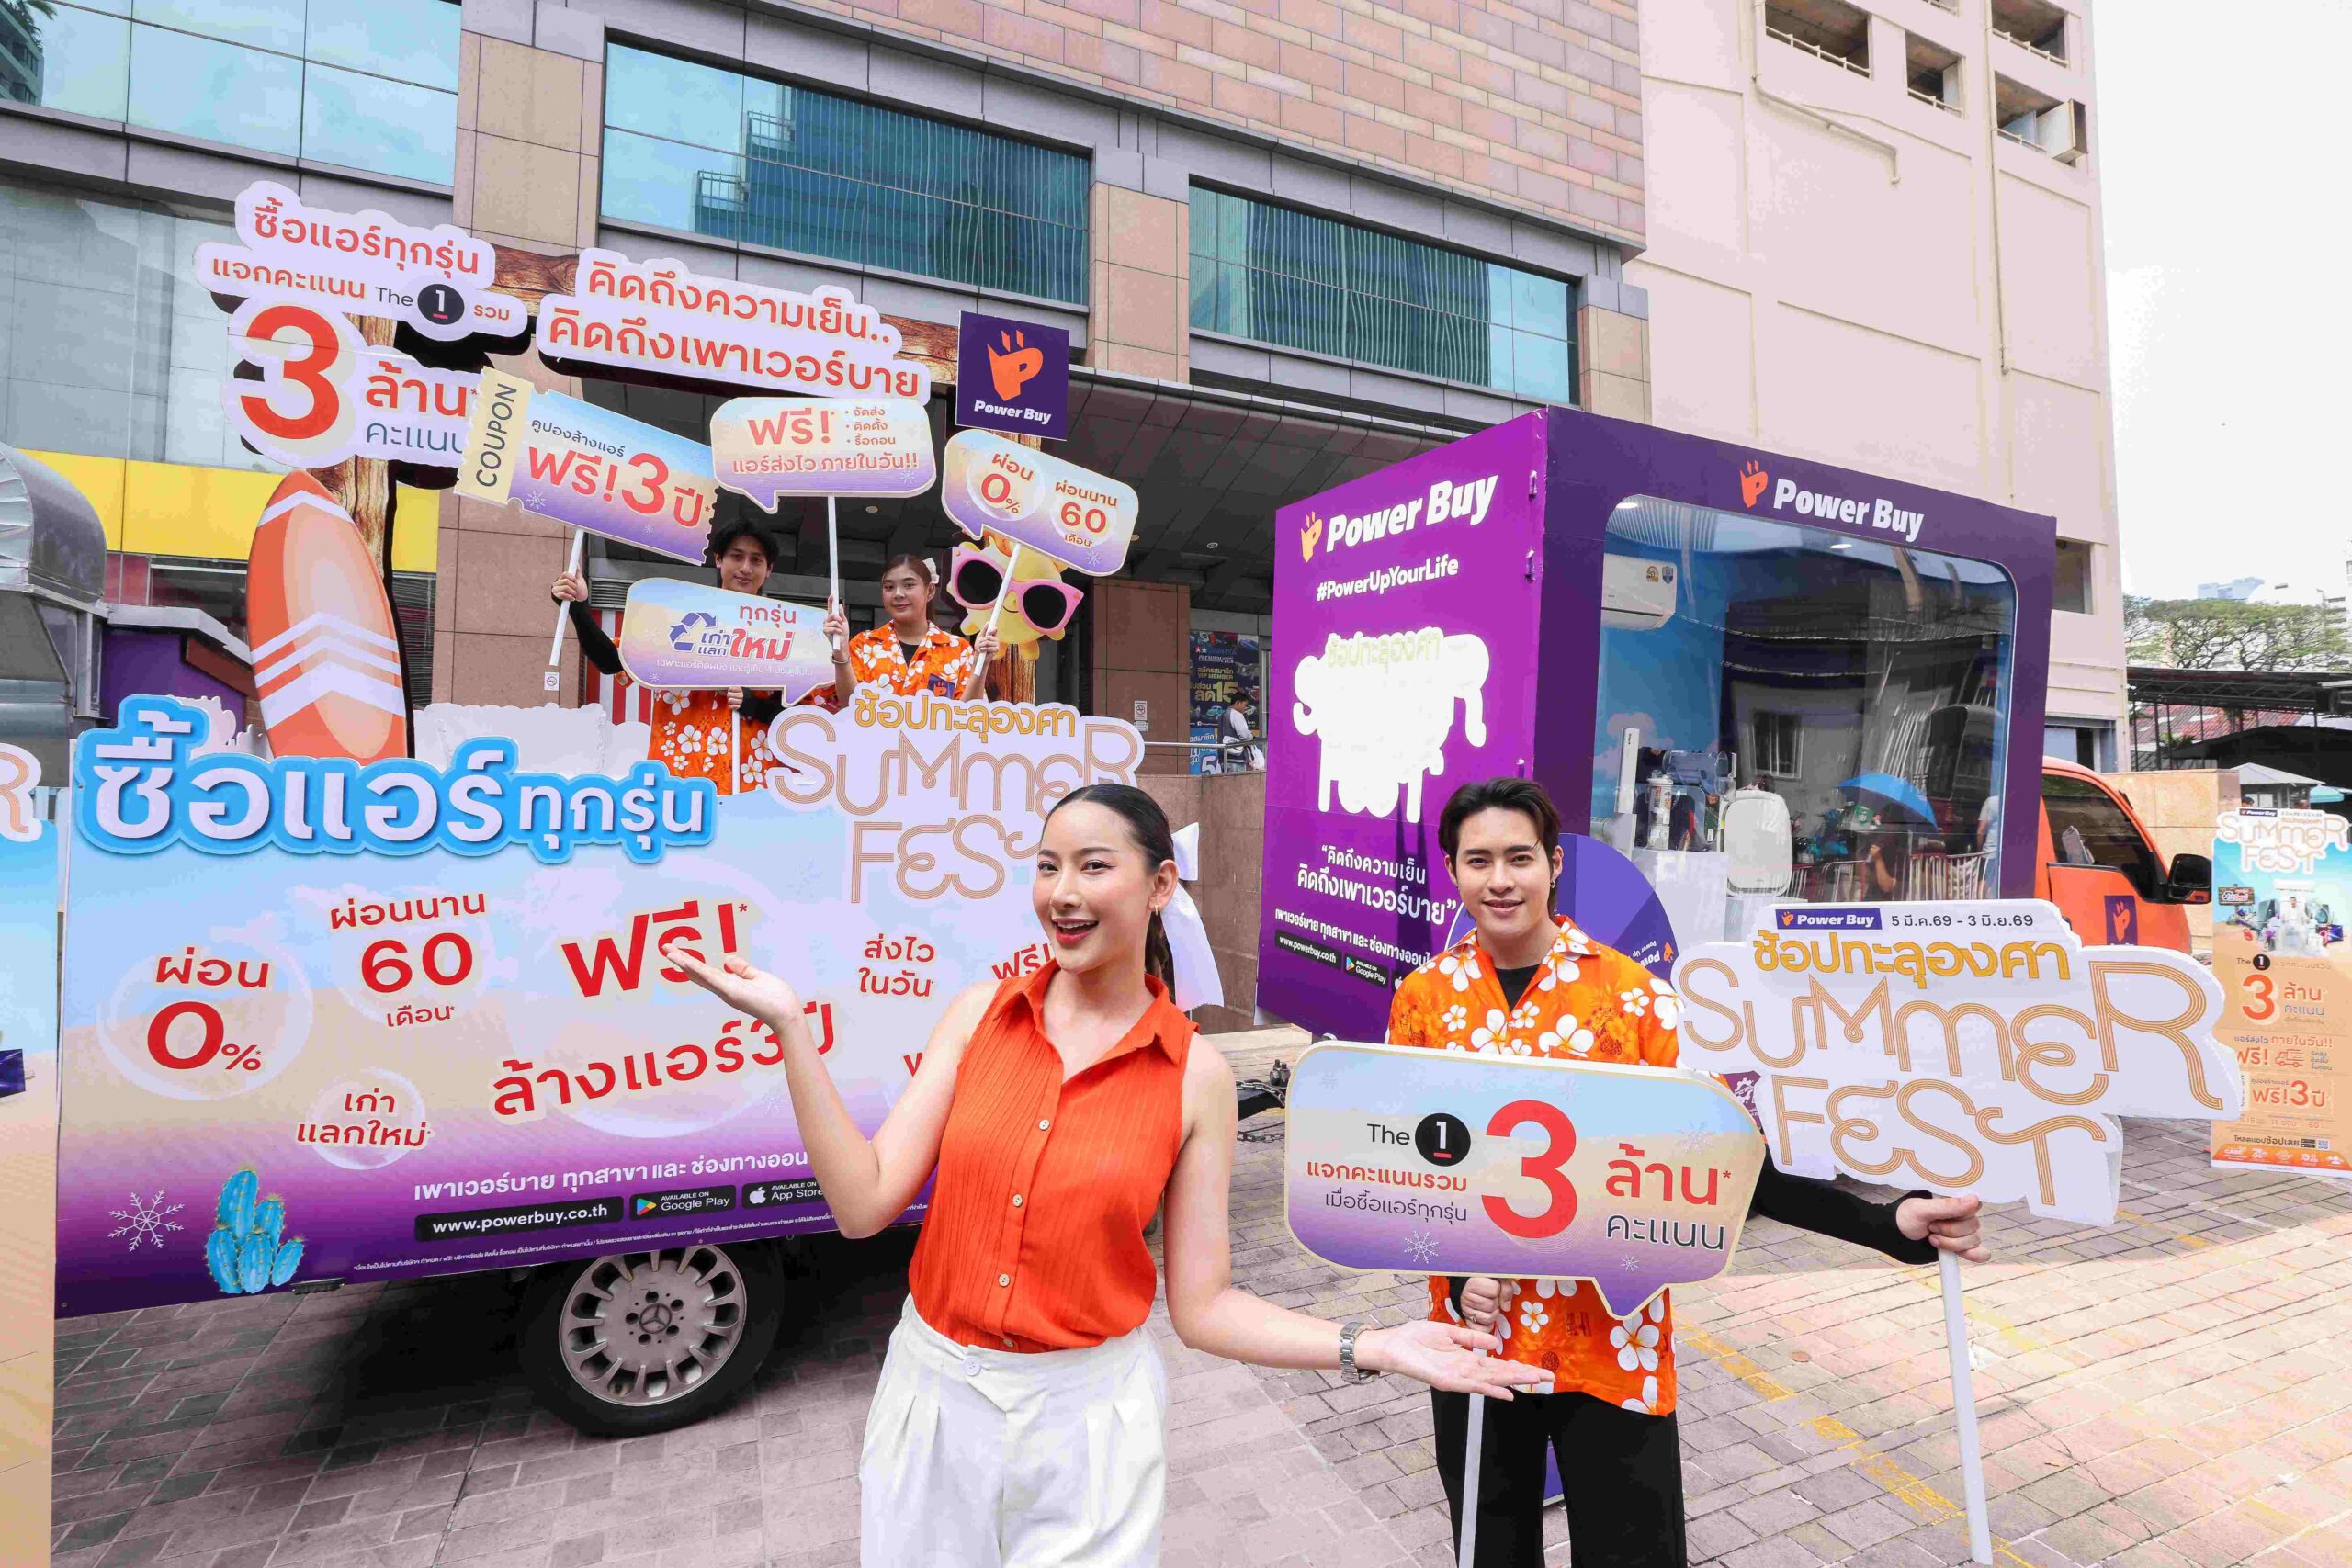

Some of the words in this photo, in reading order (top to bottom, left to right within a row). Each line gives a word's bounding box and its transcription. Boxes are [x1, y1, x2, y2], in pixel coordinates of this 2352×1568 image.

[254, 197, 479, 279] ซื้อแอร์ทุกรุ่น
[212, 258, 365, 299] แจกคะแนน
[375, 287, 413, 306] The
[474, 304, 510, 321] รวม
[588, 260, 889, 343] คิดถึงความเย็น..
[549, 307, 919, 397] คิดถึงเพาเวอร์บาย
[241, 305, 340, 439] 3
[853, 406, 886, 417] จัดส่ง
[854, 420, 888, 432] ติดตั้ง
[974, 400, 1023, 421] Power
[1023, 408, 1052, 426] Buy
[476, 383, 517, 487] COUPON
[531, 417, 626, 457] คูปองล้างแอร์
[734, 453, 817, 473] แอร์ส่งไว
[821, 452, 919, 470] ภายในวัน!!
[991, 453, 1035, 481] ผ่อน
[1055, 479, 1118, 507] ผ่อนนาน
[1060, 502, 1107, 533] 60
[1326, 498, 1423, 553] Power
[1426, 474, 1498, 525] Buy
[1773, 478, 1871, 525] Power
[1872, 498, 1925, 543] Buy
[1317, 553, 1459, 602] #PowerUpYourLife
[740, 604, 797, 627] ทุกรุ่น
[697, 646, 727, 656] แลก
[701, 629, 730, 645] เก่า
[730, 628, 795, 660] ใหม่
[854, 689, 1075, 744] ช้อปทะลุองศา
[2245, 844, 2324, 872] FEST
[330, 893, 486, 929] ผ่อนนาน
[1797, 913, 1843, 926] Power
[1846, 913, 1875, 928] Buy
[1891, 915, 1900, 927] 5
[1904, 913, 1951, 927] มี.ค.69
[1967, 915, 1976, 927] 3
[1981, 913, 2033, 927] มิ.ย.69
[863, 933, 935, 963] ส่งไว
[1275, 908, 1319, 932] เพาเวอร์บาย
[1320, 922, 1352, 944] ทุกสาขา
[1352, 933, 1369, 948] และ
[1369, 934, 1430, 965] ช่องทางออนไ
[1279, 935, 1337, 964] www.powerbuy.co.th
[156, 946, 269, 988] ผ่อน
[361, 932, 473, 993] 60
[1640, 950, 1661, 967] Pow
[1753, 930, 2071, 989] ช้อปทะลุองศา
[2236, 957, 2251, 965] The
[1355, 965, 1374, 980] Google
[1374, 971, 1386, 985] Play
[2242, 974, 2275, 1021] 3
[2284, 1005, 2324, 1016] คะแนน
[1679, 957, 2223, 1111] SUMMER
[2270, 1035, 2333, 1047] ภายในวัน!!
[344, 1088, 396, 1113] เก่า
[2253, 1088, 2288, 1104] ฟรี!
[2290, 1080, 2309, 1106] 3
[1366, 1122, 1410, 1145] The
[1770, 1073, 2107, 1208] FEST
[414, 1168, 555, 1202] เพาเวอร์บาย
[562, 1162, 648, 1194] ทุกสาขา
[651, 1158, 686, 1179] และ
[692, 1146, 808, 1178] ช่องทางออน
[1306, 1159, 1467, 1192] แจกคะแนนรวม
[1481, 1100, 1578, 1239] 3
[661, 1192, 697, 1201] AVAILABLE
[771, 1182, 805, 1191] AVAILABLE
[771, 1191, 794, 1202] App
[433, 1204, 607, 1235] www.powerbuy.co.th
[661, 1200, 703, 1213] Google
[705, 1197, 730, 1209] Play
[1324, 1189, 1467, 1224] เมื่อซื้อแอร์ทุกรุ่น
[1606, 1213, 1725, 1250] คะแนน
